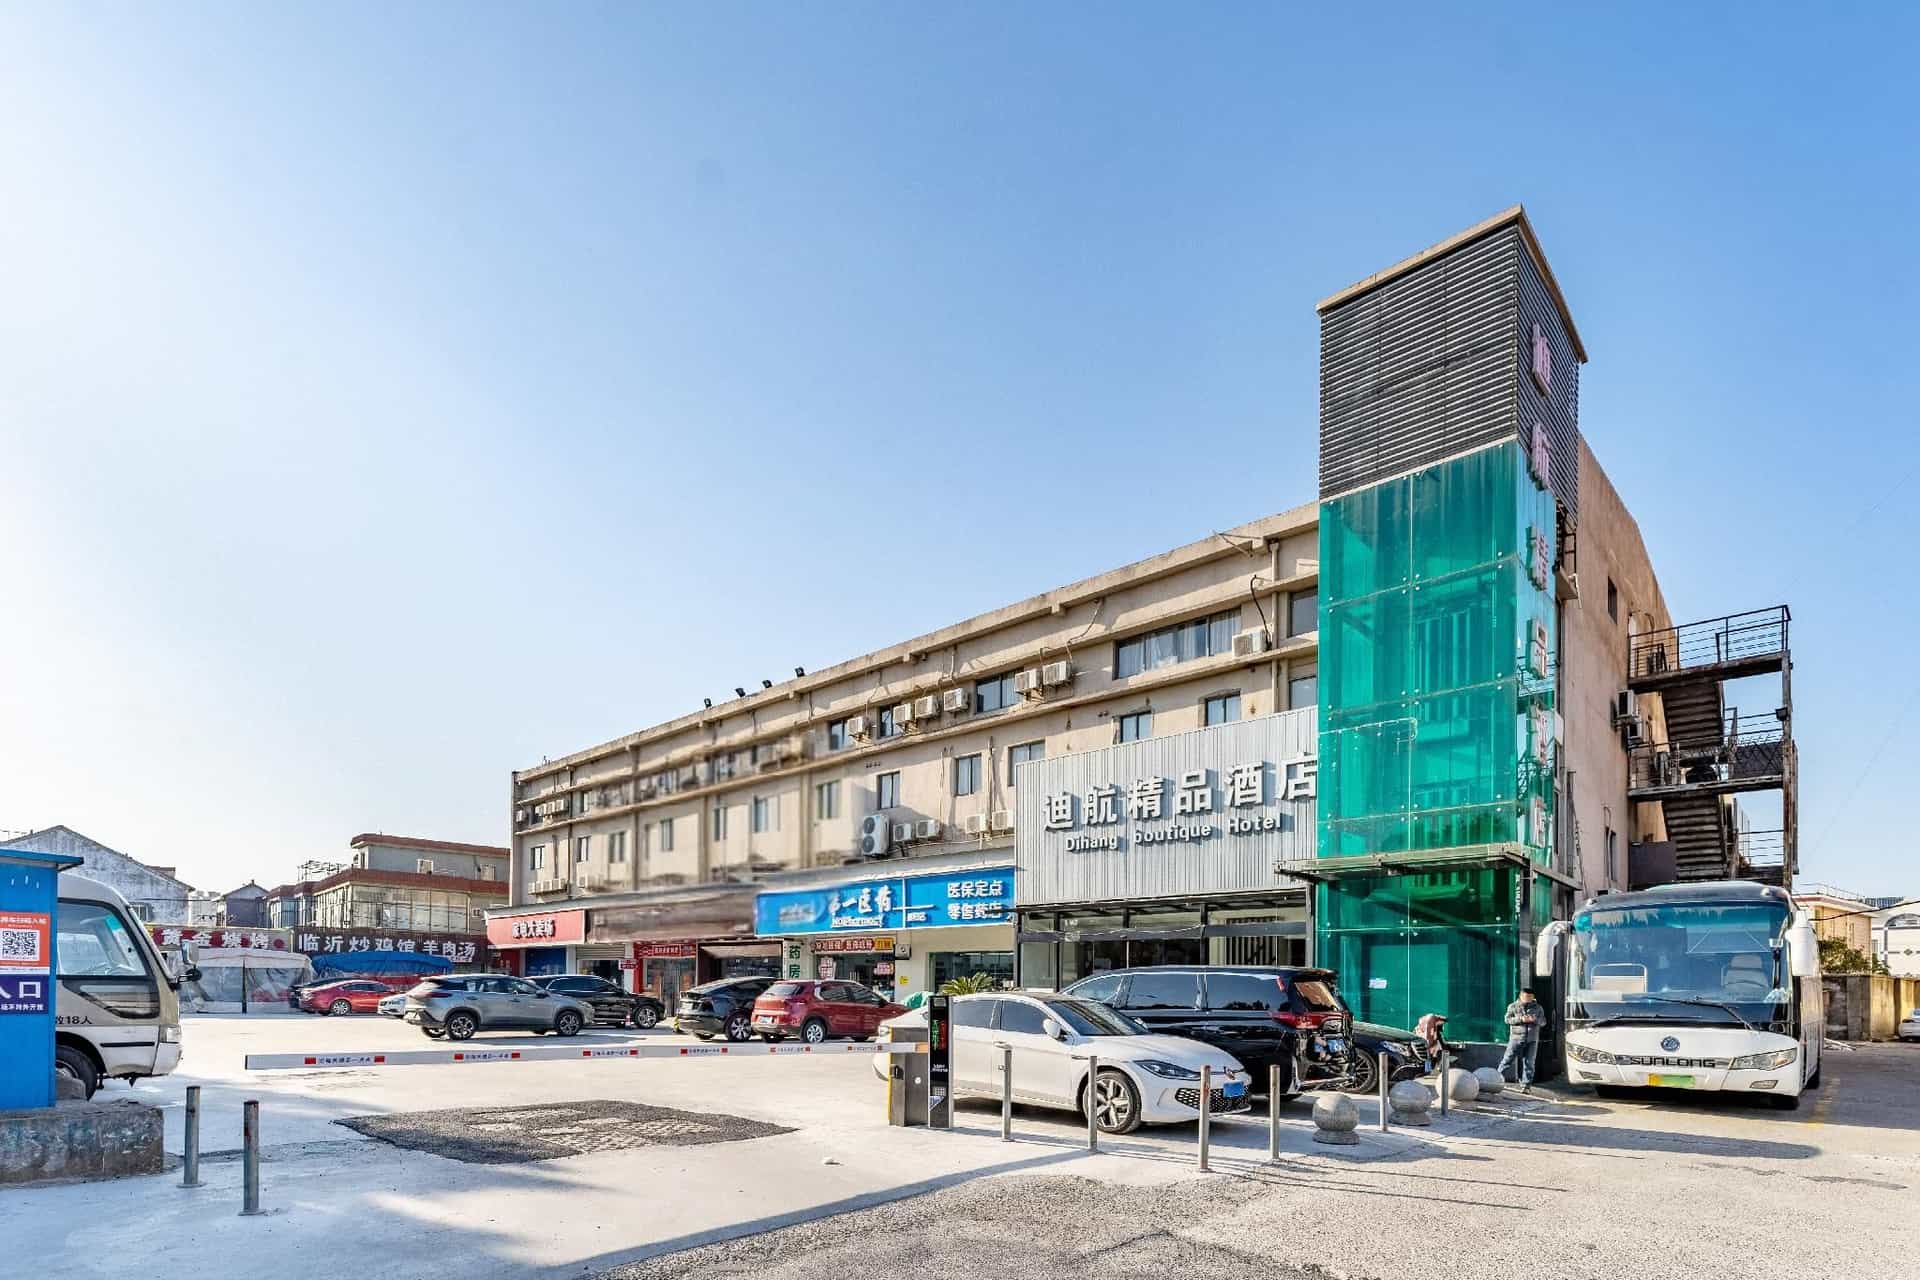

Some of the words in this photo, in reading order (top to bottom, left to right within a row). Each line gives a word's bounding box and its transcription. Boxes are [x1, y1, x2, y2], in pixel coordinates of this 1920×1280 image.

[1044, 751, 1318, 832] 迪航精品酒店
[1065, 837, 1119, 853] Dihang
[1134, 821, 1213, 846] boutique
[1227, 815, 1282, 835] Hotel
[947, 880, 1003, 899] 医保定点
[947, 902, 1003, 920] 零售药店
[299, 933, 417, 953] 临沂炒鸡馆
[422, 941, 477, 957] 羊肉汤
[789, 945, 801, 978] 药房
[1631, 1055, 1716, 1068] SUNLONG
